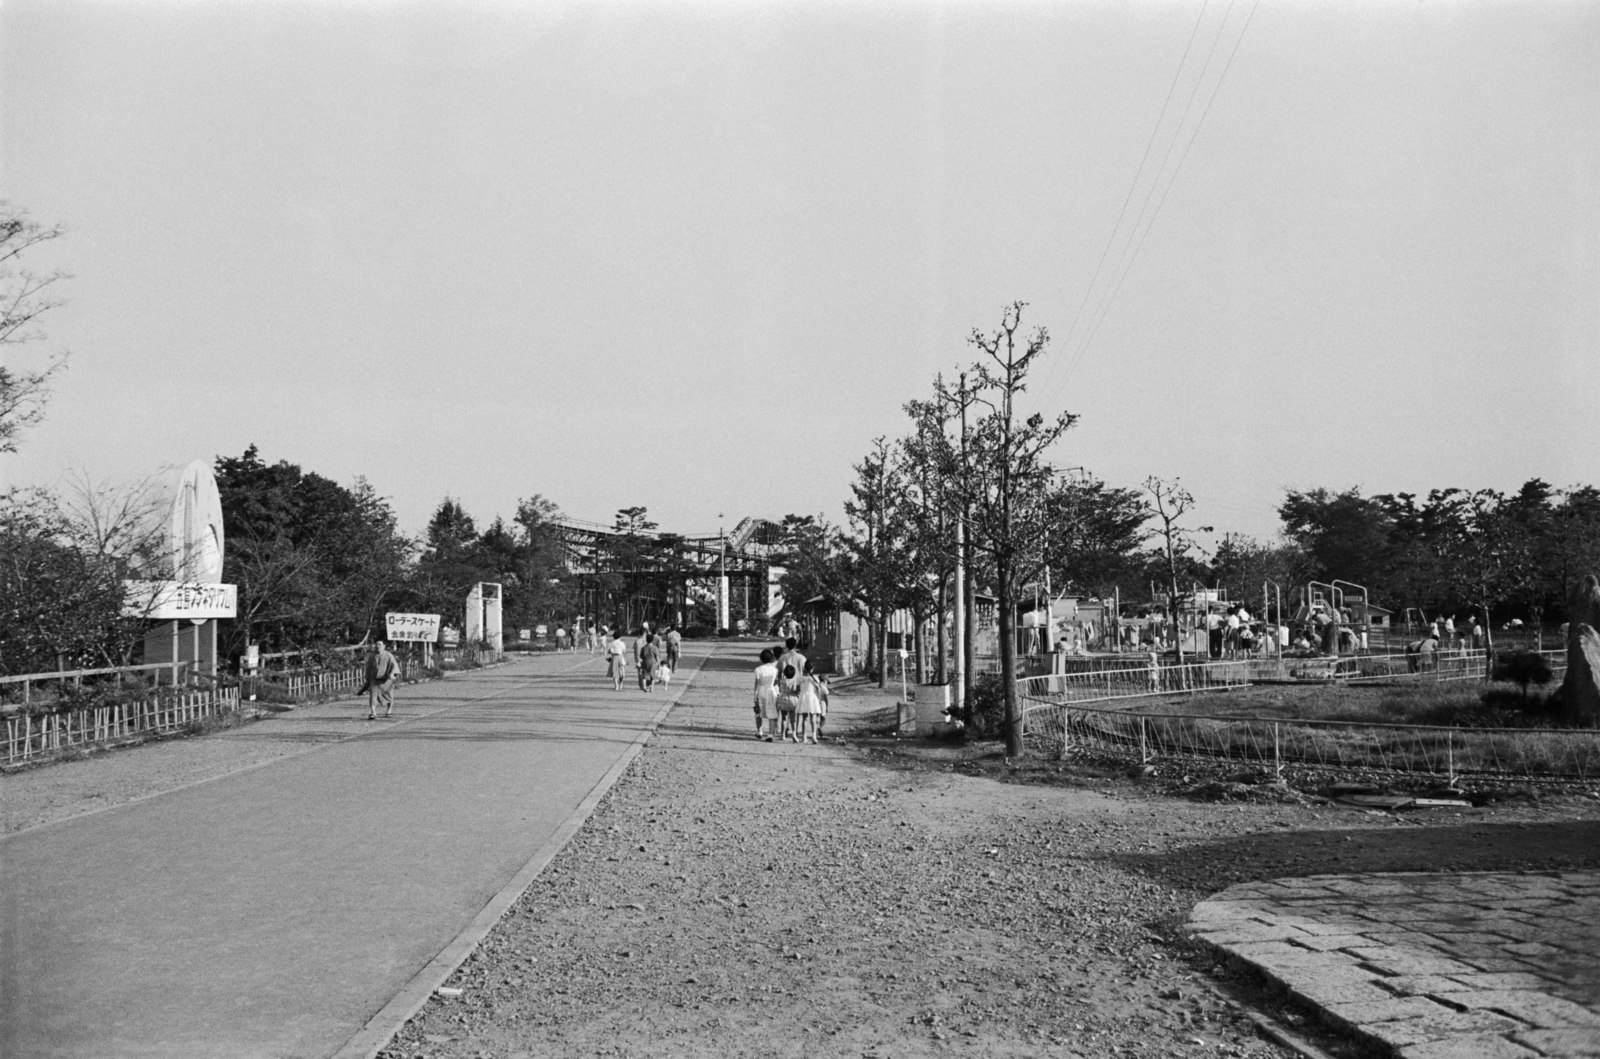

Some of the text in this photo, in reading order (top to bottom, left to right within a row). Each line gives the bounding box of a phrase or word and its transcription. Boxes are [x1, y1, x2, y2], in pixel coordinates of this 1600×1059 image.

[388, 616, 436, 626] ローラースケート
